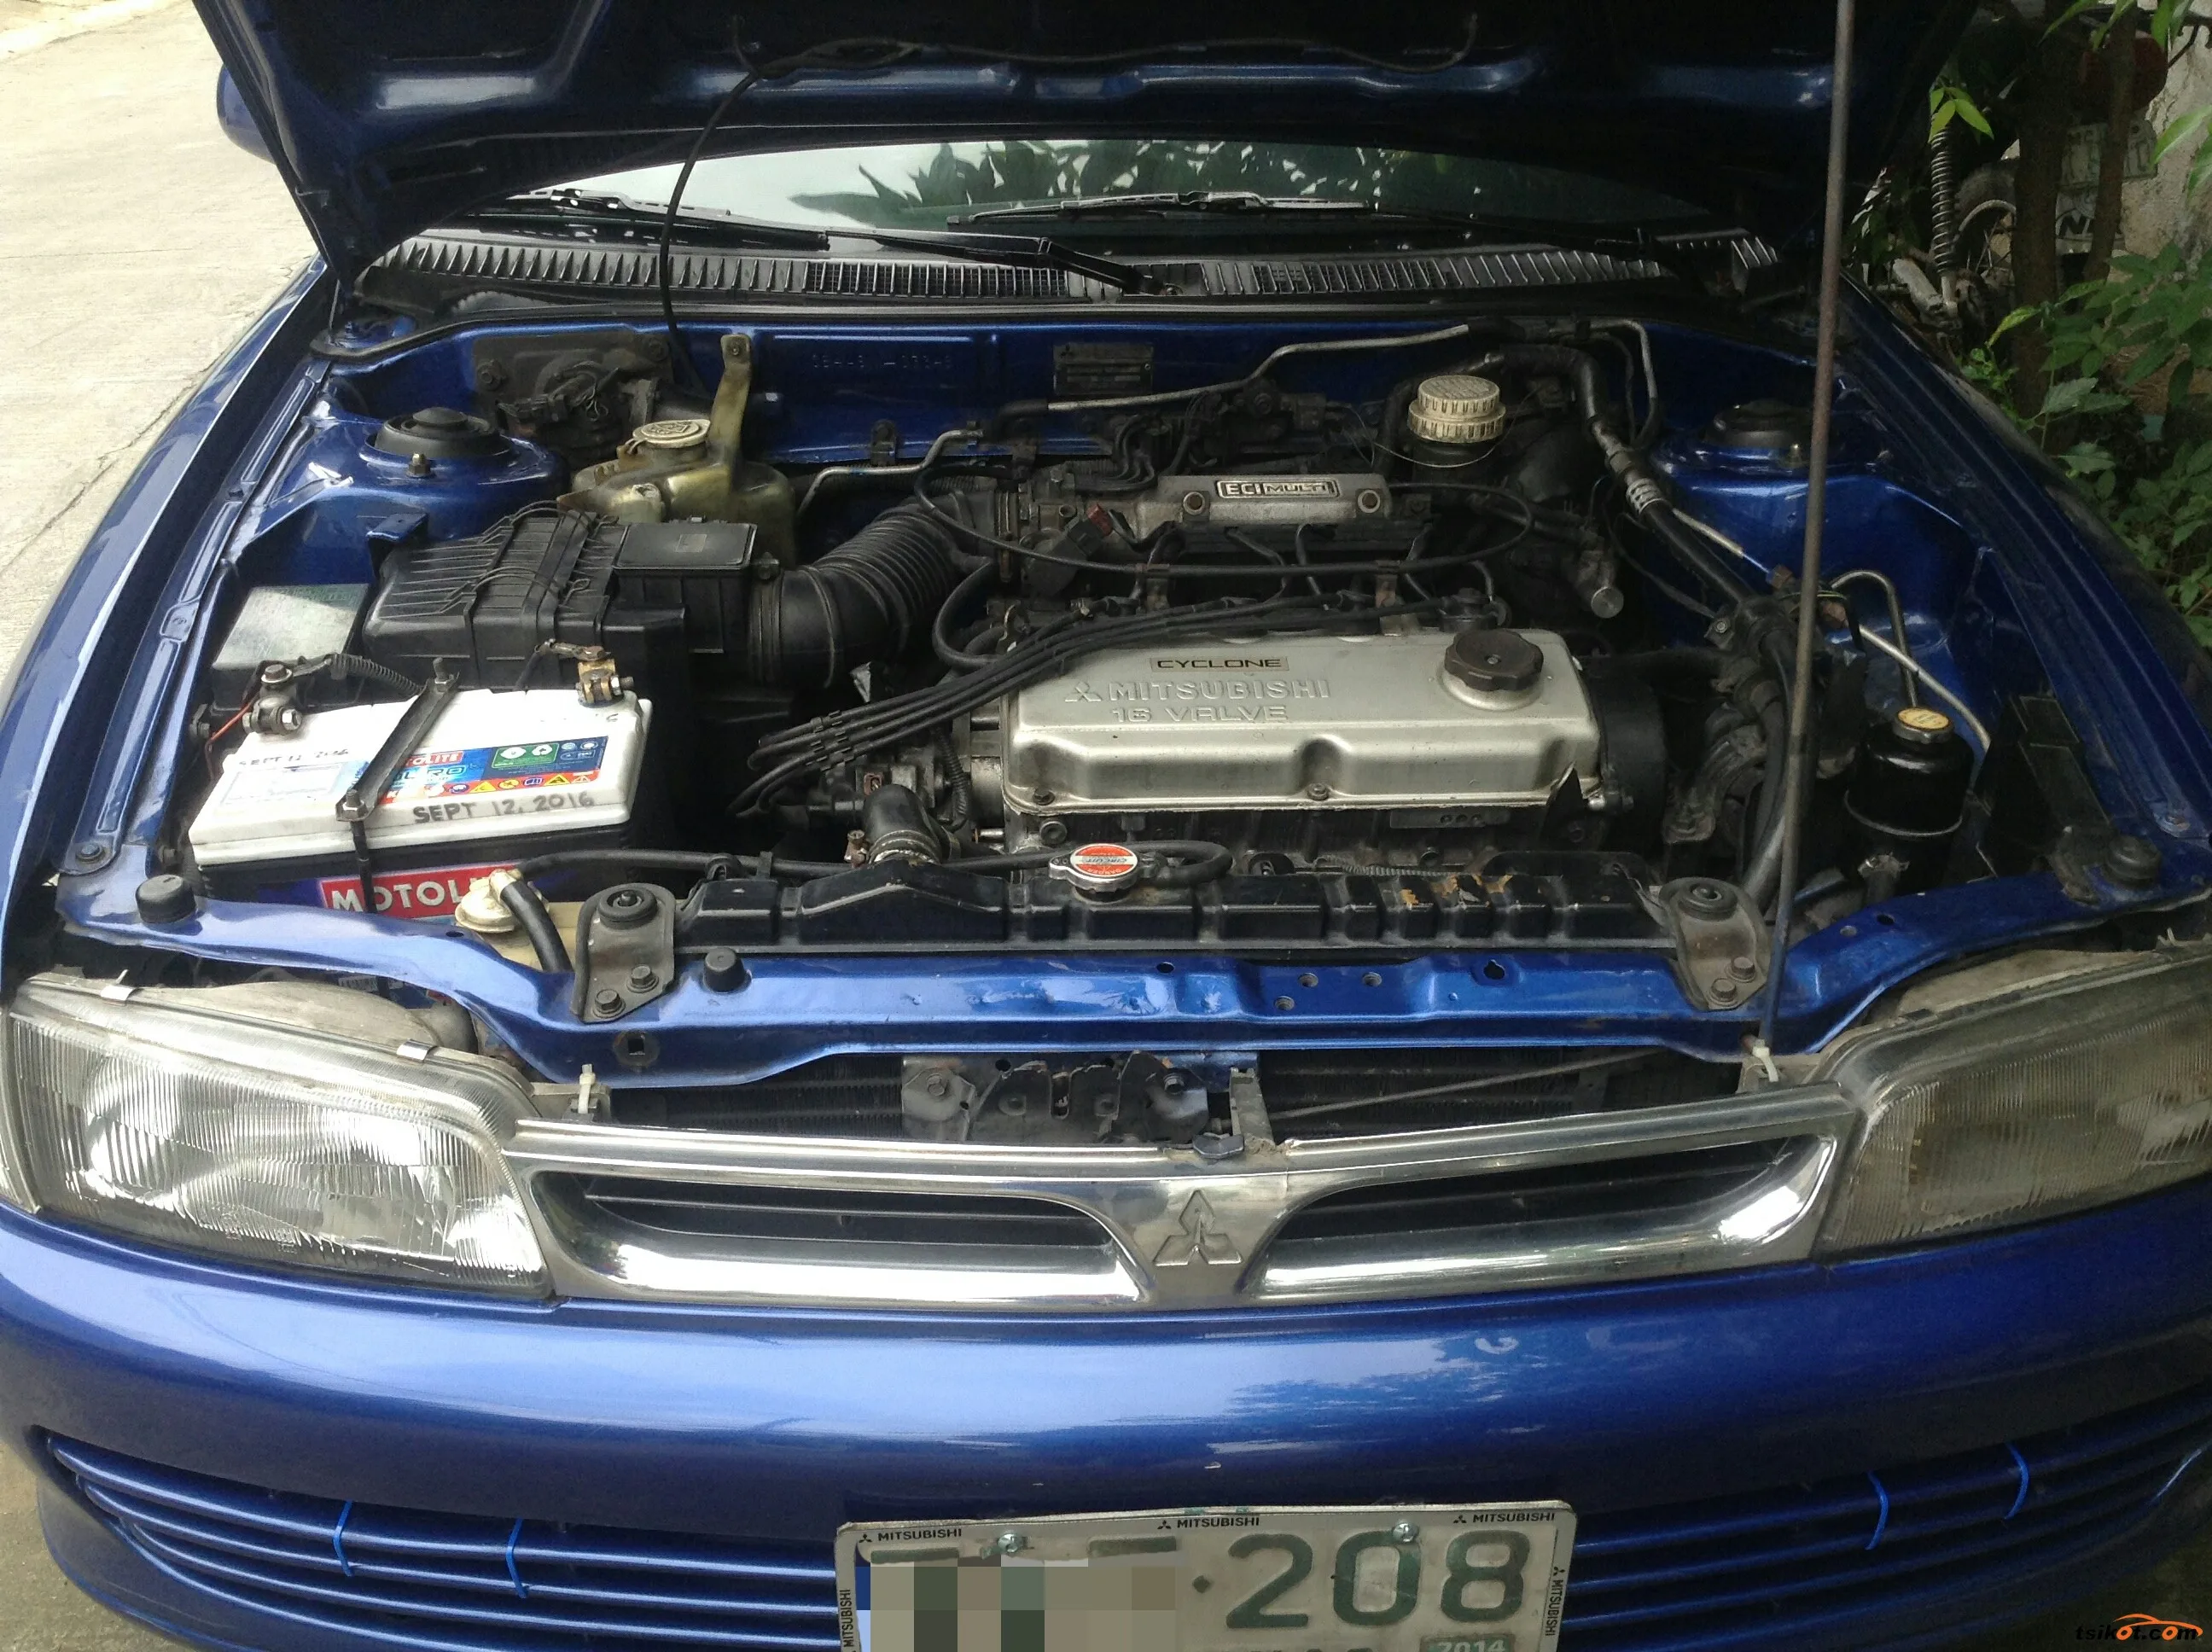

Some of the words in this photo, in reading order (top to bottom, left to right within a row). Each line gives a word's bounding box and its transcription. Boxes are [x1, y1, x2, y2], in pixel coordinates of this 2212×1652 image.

[1225, 483, 1261, 495] ECI
[1266, 484, 1326, 492] MULTI
[1156, 659, 1282, 669] CYCLONE
[1109, 680, 1332, 701] MITSUBISHI
[1112, 706, 1152, 723] 16
[1164, 705, 1289, 722] VALVE
[413, 802, 476, 823] SEPT
[533, 792, 595, 811] 2016
[331, 877, 490, 912] MOTOL
[1177, 1517, 1260, 1529] MITSUBISHI
[1473, 1512, 1555, 1523] MITSUBISHI
[878, 1528, 962, 1542] MITSUBISHI
[1545, 1579, 1563, 1637] MITSUBISHI
[839, 1589, 854, 1648] MITSUBISHI
